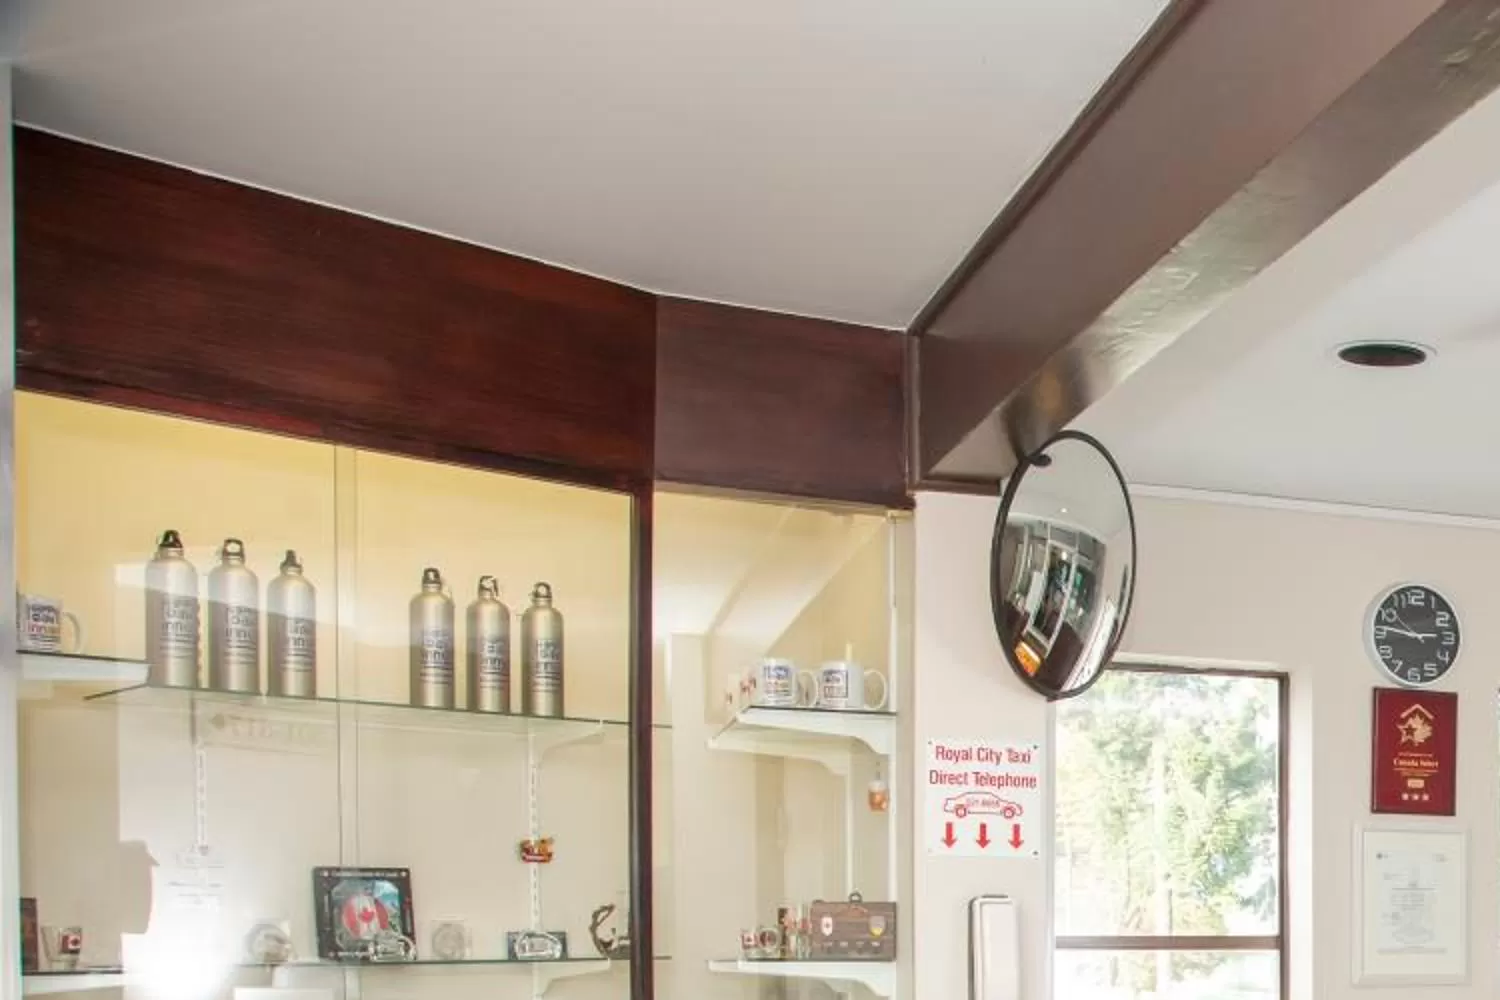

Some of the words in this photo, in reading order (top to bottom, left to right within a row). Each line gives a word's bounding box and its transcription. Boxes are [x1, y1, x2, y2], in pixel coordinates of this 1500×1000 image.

[1392, 593, 1406, 608] 11
[1406, 589, 1425, 606] 12
[1430, 595, 1436, 609] 1
[1379, 607, 1397, 623] 10
[1435, 611, 1450, 627] 2
[1441, 631, 1456, 645] 3
[1379, 645, 1392, 659] 8
[1437, 649, 1450, 664] 4
[1391, 659, 1403, 673] 7
[1423, 663, 1438, 677] 5
[1407, 667, 1421, 681] 6
[935, 745, 973, 763] Royal
[977, 746, 1003, 766] City
[1007, 748, 1032, 764] Taxi
[929, 769, 969, 786] Direct
[972, 771, 1037, 789] Telephone
